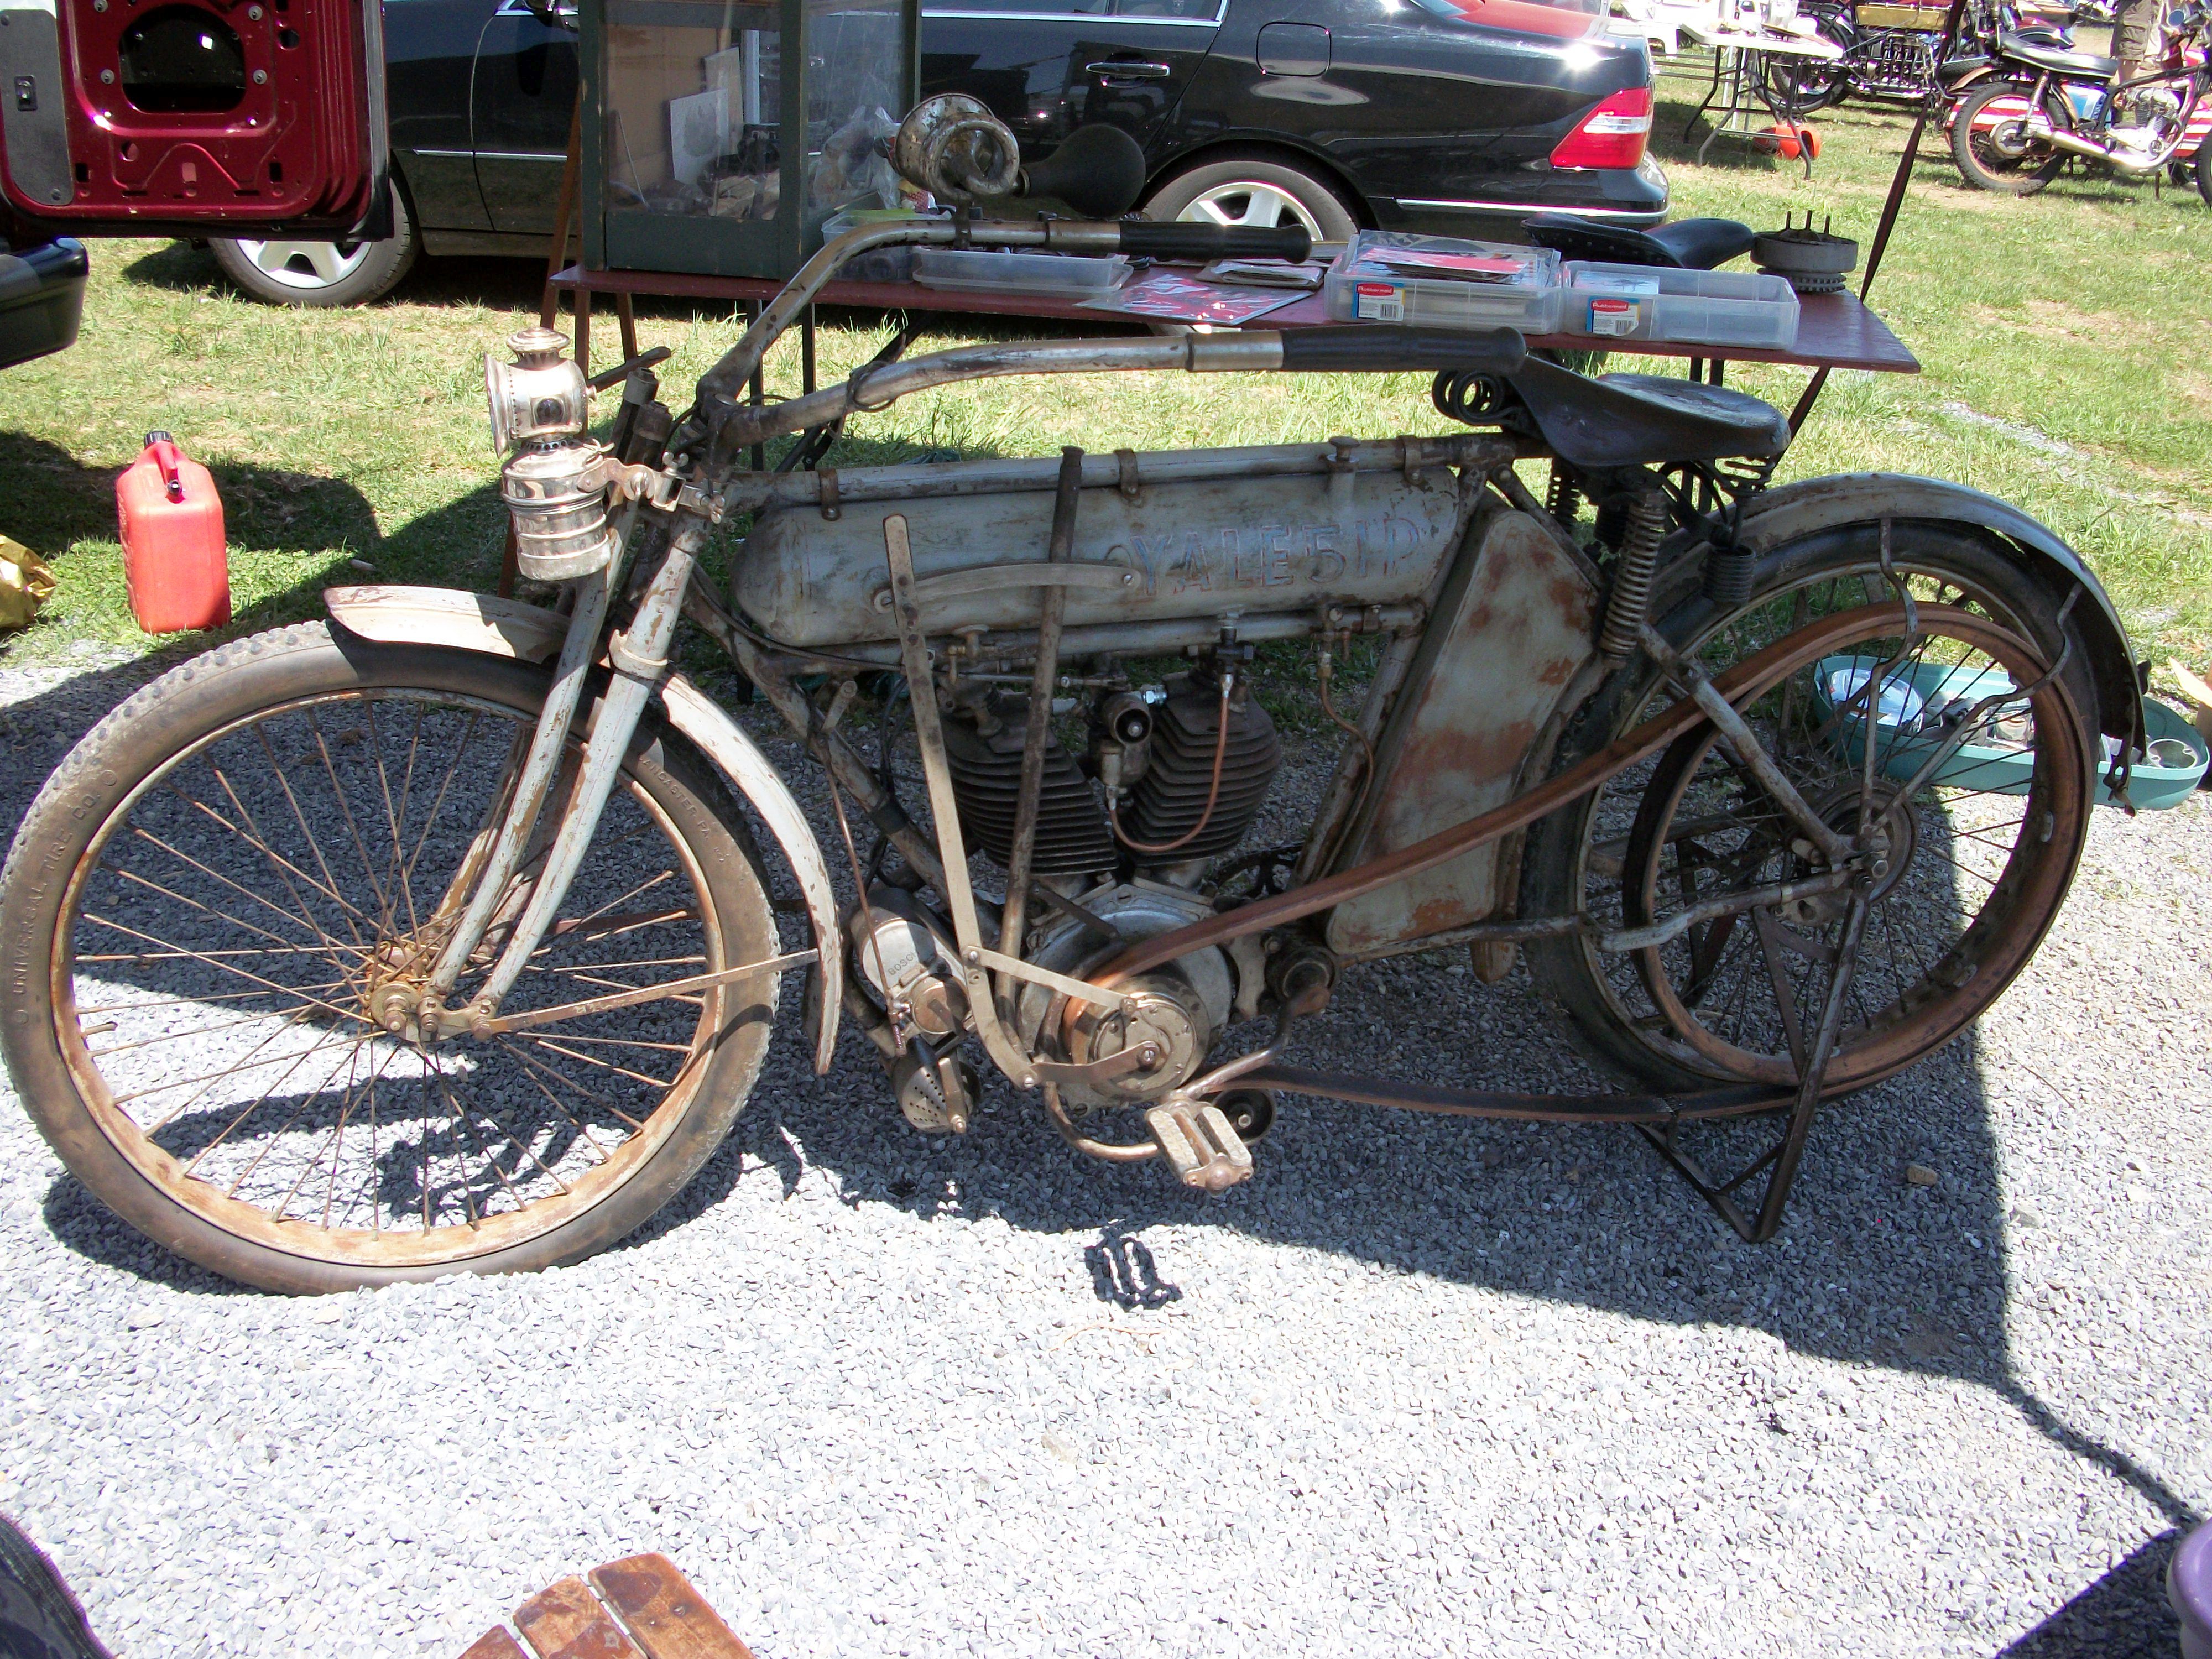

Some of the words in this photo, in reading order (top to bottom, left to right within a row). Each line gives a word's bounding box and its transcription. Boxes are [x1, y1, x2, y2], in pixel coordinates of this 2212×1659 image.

[1358, 285, 1392, 294] Rubbermaid
[1130, 524, 1295, 596] YALE
[1301, 523, 1347, 585] 5
[13, 882, 48, 995] UNIVERSAL
[41, 828, 73, 872] TIRE
[72, 793, 101, 821] CO.
